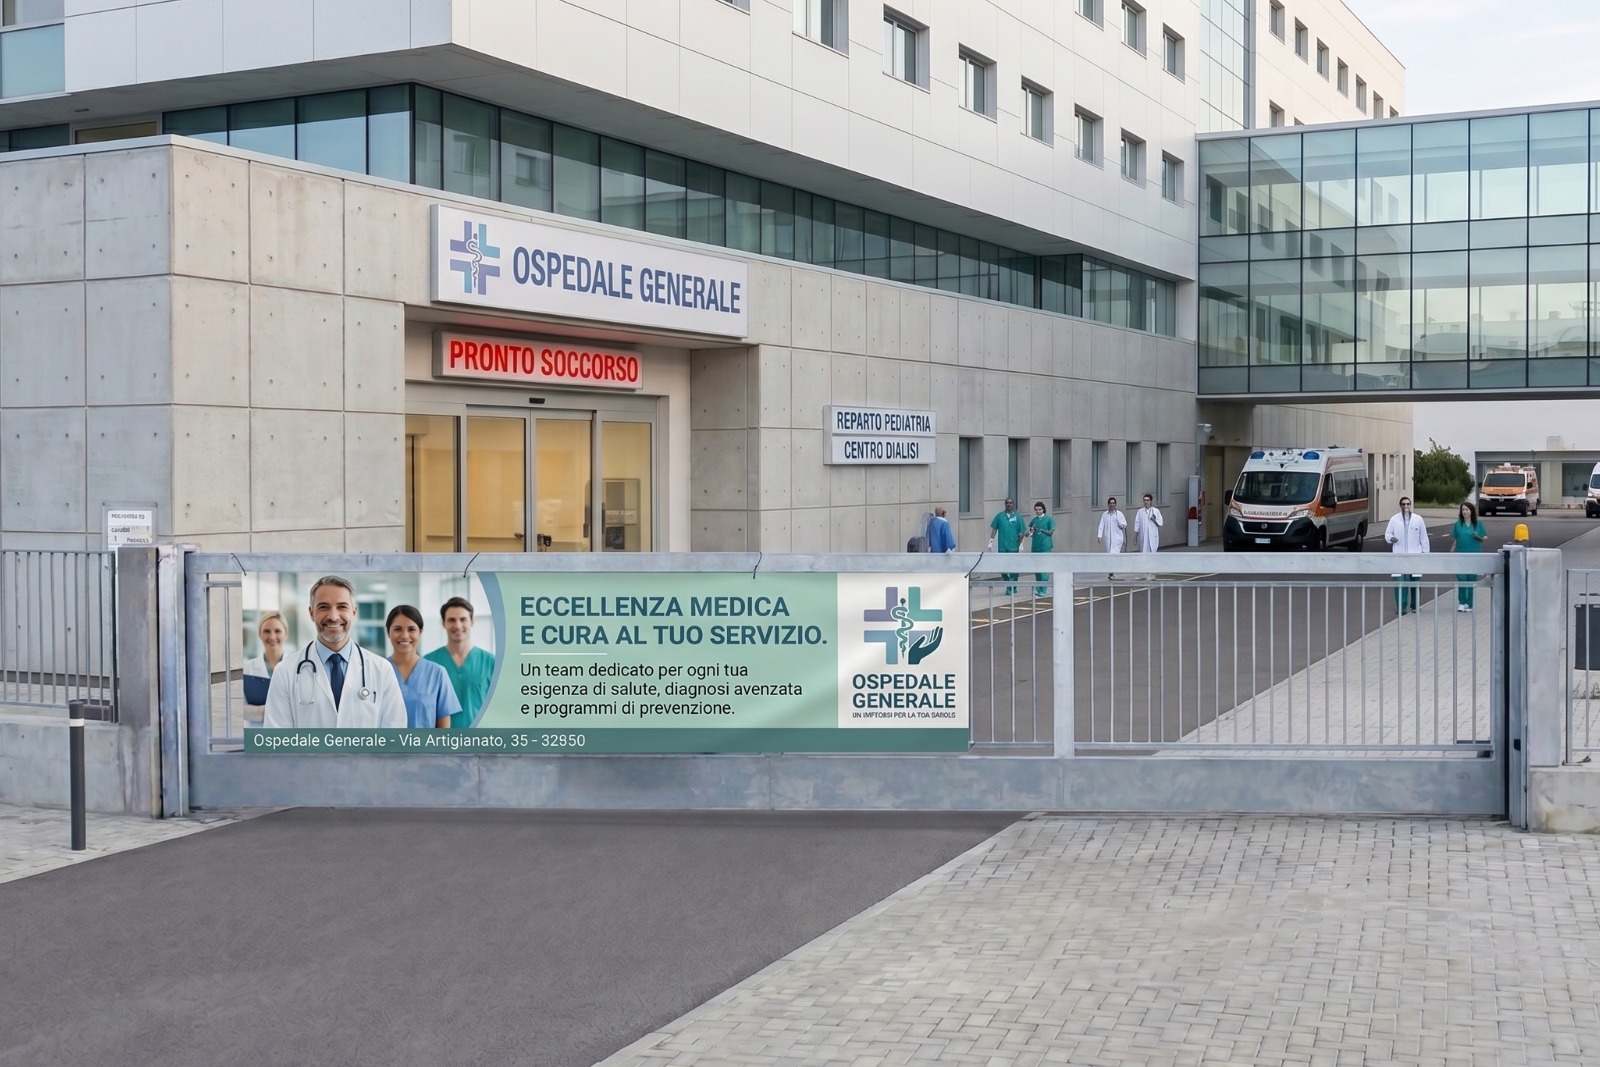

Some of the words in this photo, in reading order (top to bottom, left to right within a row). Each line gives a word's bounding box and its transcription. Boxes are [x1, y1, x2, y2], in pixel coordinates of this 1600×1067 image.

[513, 246, 633, 299] OSPEDALE
[640, 267, 741, 314] GENERALE
[450, 340, 535, 375] PRONTO
[541, 348, 639, 383] SOCCORSO
[837, 411, 882, 431] REPARTO
[885, 413, 931, 432] PEDIATRIA
[844, 441, 883, 459] CENTRO
[886, 442, 919, 459] DIALISI
[521, 597, 683, 617] ECCELLENZA
[690, 597, 790, 617] MEDICA
[521, 625, 535, 645] E
[541, 625, 609, 645] CURA
[615, 625, 647, 645] AL
[653, 625, 704, 645] TUO
[709, 625, 828, 645] SERVIZIO.
[521, 663, 541, 677] Un
[545, 664, 584, 677] team
[589, 663, 655, 677] dedicato
[659, 666, 684, 680] per
[687, 663, 720, 680] ogni
[724, 664, 749, 677] tua
[521, 682, 588, 699] esigenza
[593, 682, 606, 696] di
[611, 682, 661, 697] salute,
[665, 682, 730, 699] diagnosi
[734, 683, 803, 696] avenzata
[853, 674, 956, 690] OSPEDALE
[521, 704, 530, 715] e
[535, 701, 617, 718] programmi
[622, 701, 635, 715] di
[640, 701, 735, 718] prevenzione.
[853, 693, 956, 709] GENERALE
[253, 733, 320, 750] Ospedale
[324, 733, 387, 747] Generale
[399, 733, 421, 747] Via
[425, 733, 506, 750] Artigianato,
[511, 734, 529, 747] 35
